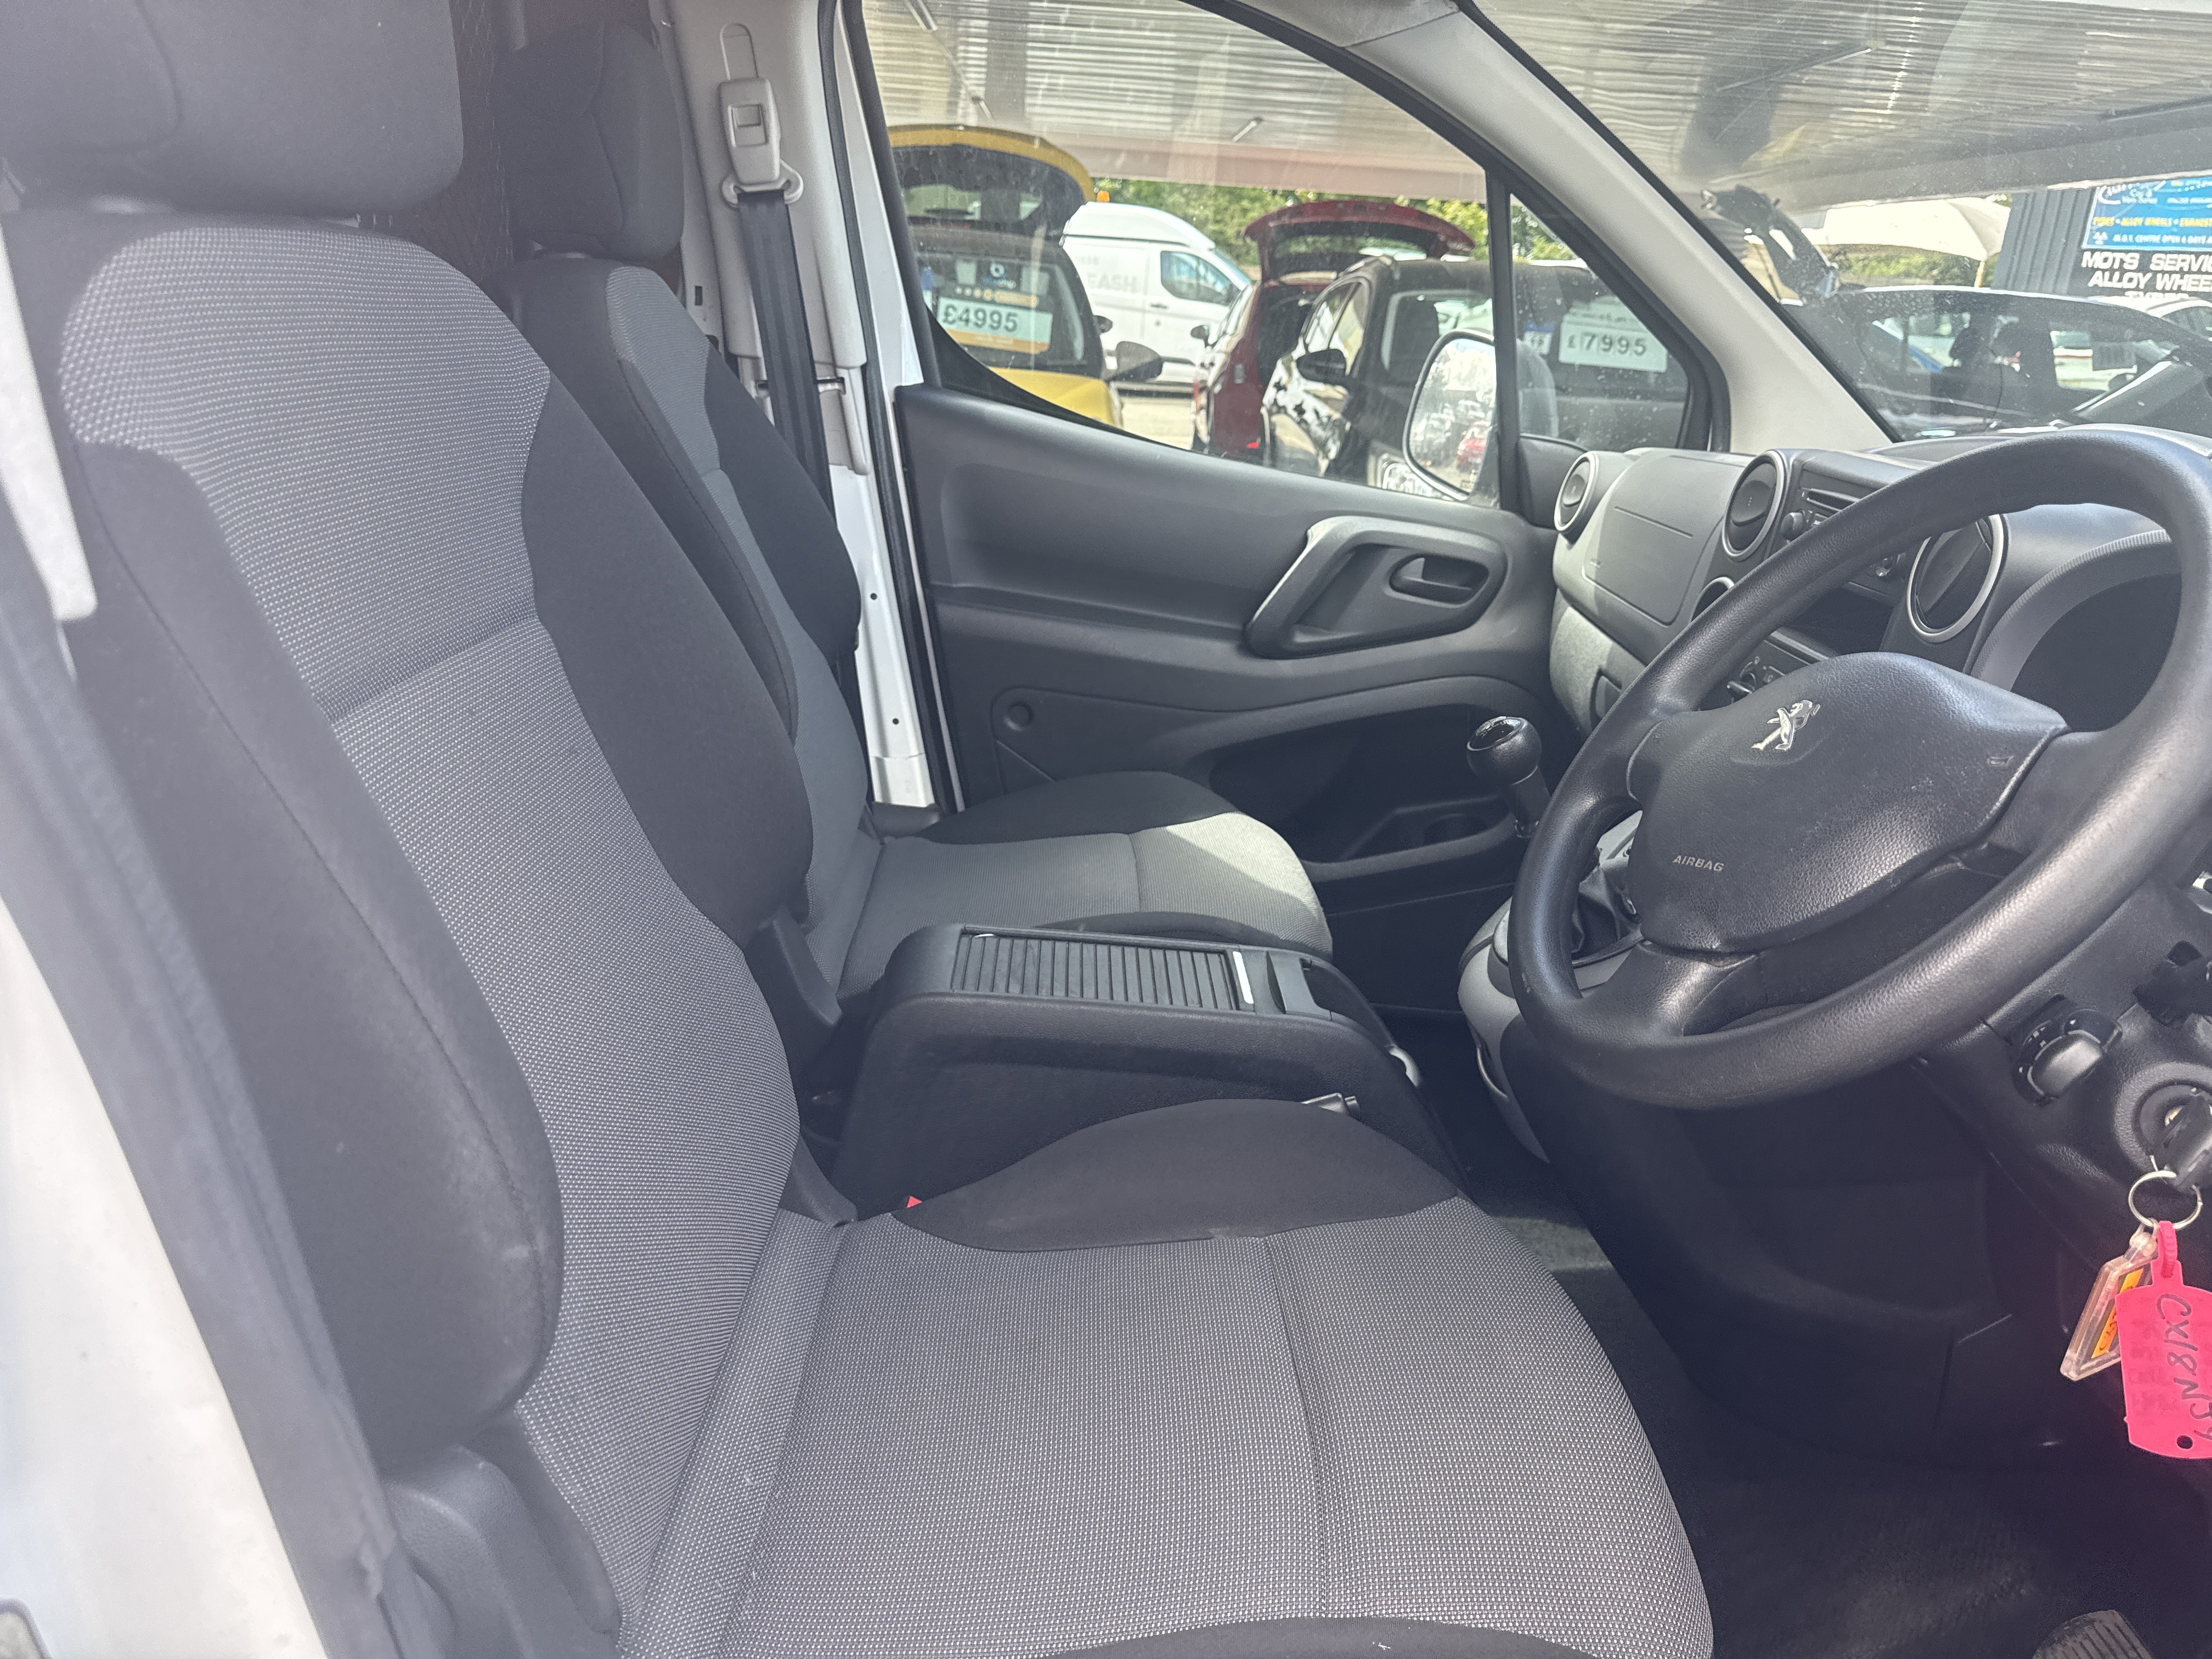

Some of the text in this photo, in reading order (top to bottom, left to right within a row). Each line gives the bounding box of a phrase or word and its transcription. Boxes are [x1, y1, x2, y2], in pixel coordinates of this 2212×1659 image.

[2081, 251, 2140, 270] MOTS
[2087, 270, 2153, 289] ALLOY
[942, 303, 1018, 332] £4995
[1673, 855, 1724, 872] AIRBAG
